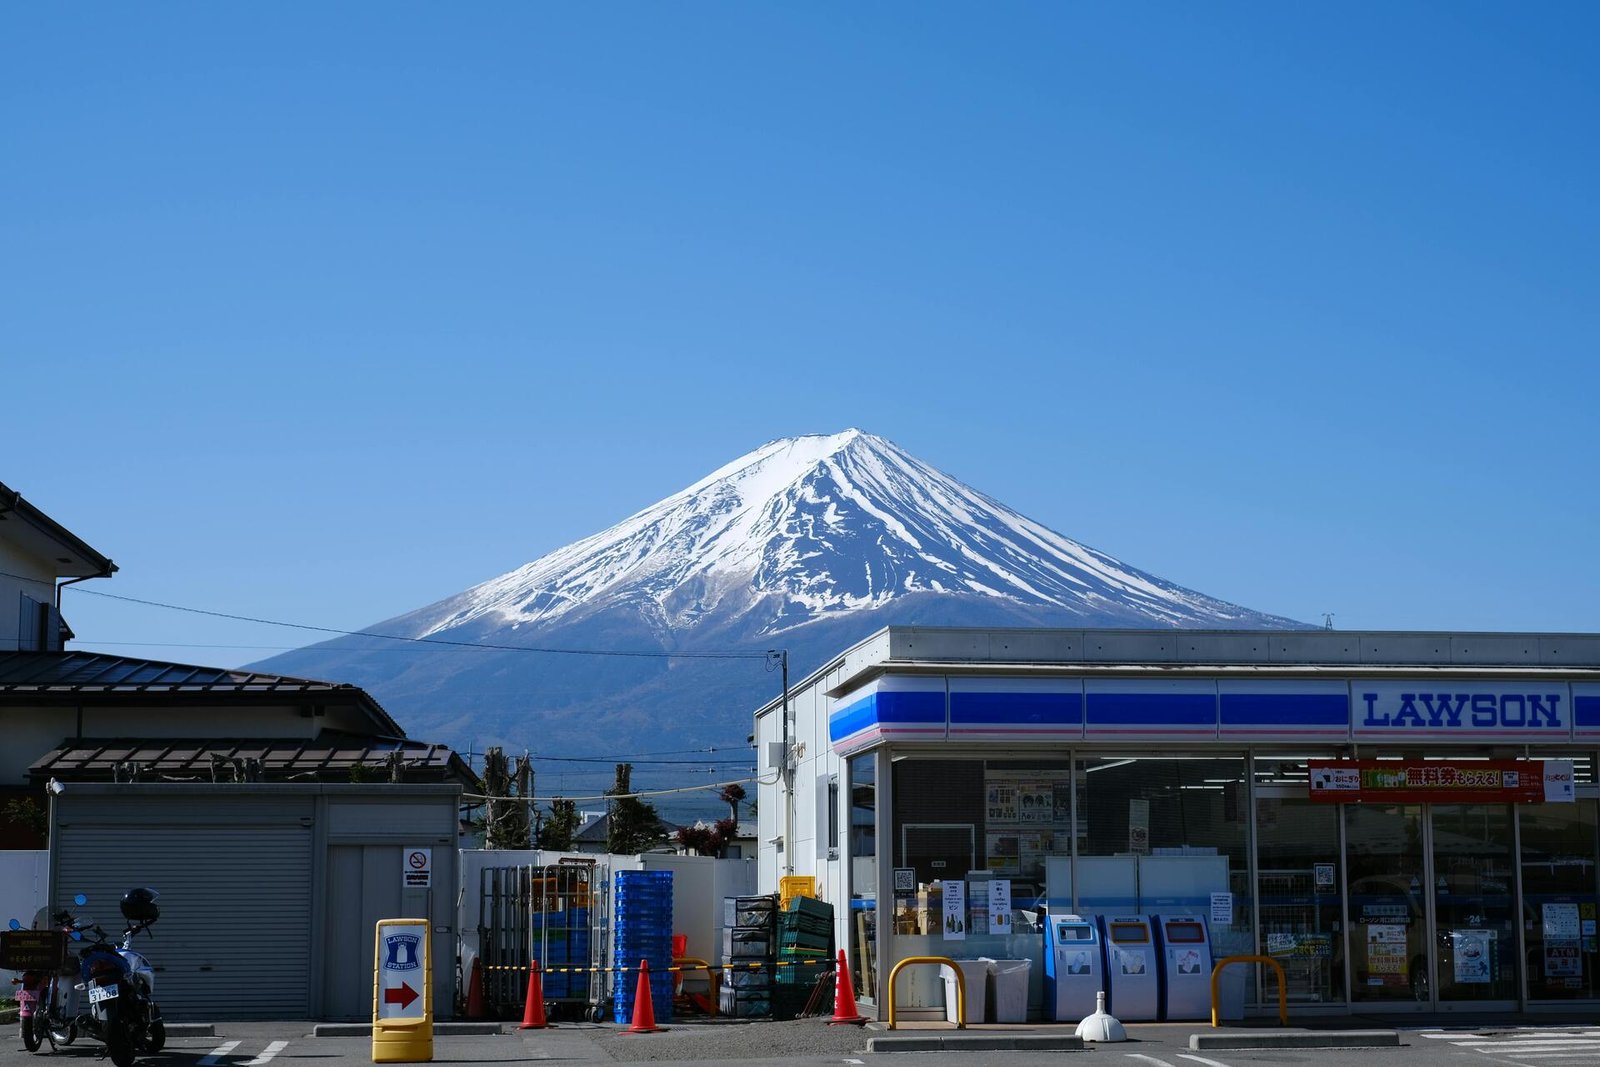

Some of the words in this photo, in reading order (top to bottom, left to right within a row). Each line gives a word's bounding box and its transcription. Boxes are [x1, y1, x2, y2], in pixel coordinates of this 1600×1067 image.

[1363, 693, 1562, 727] LAWSON
[1335, 775, 1359, 783] おにぎり
[1469, 914, 1481, 923] 24
[387, 936, 419, 944] LAWSON
[1552, 948, 1576, 957] ATM
[387, 961, 419, 969] STATION
